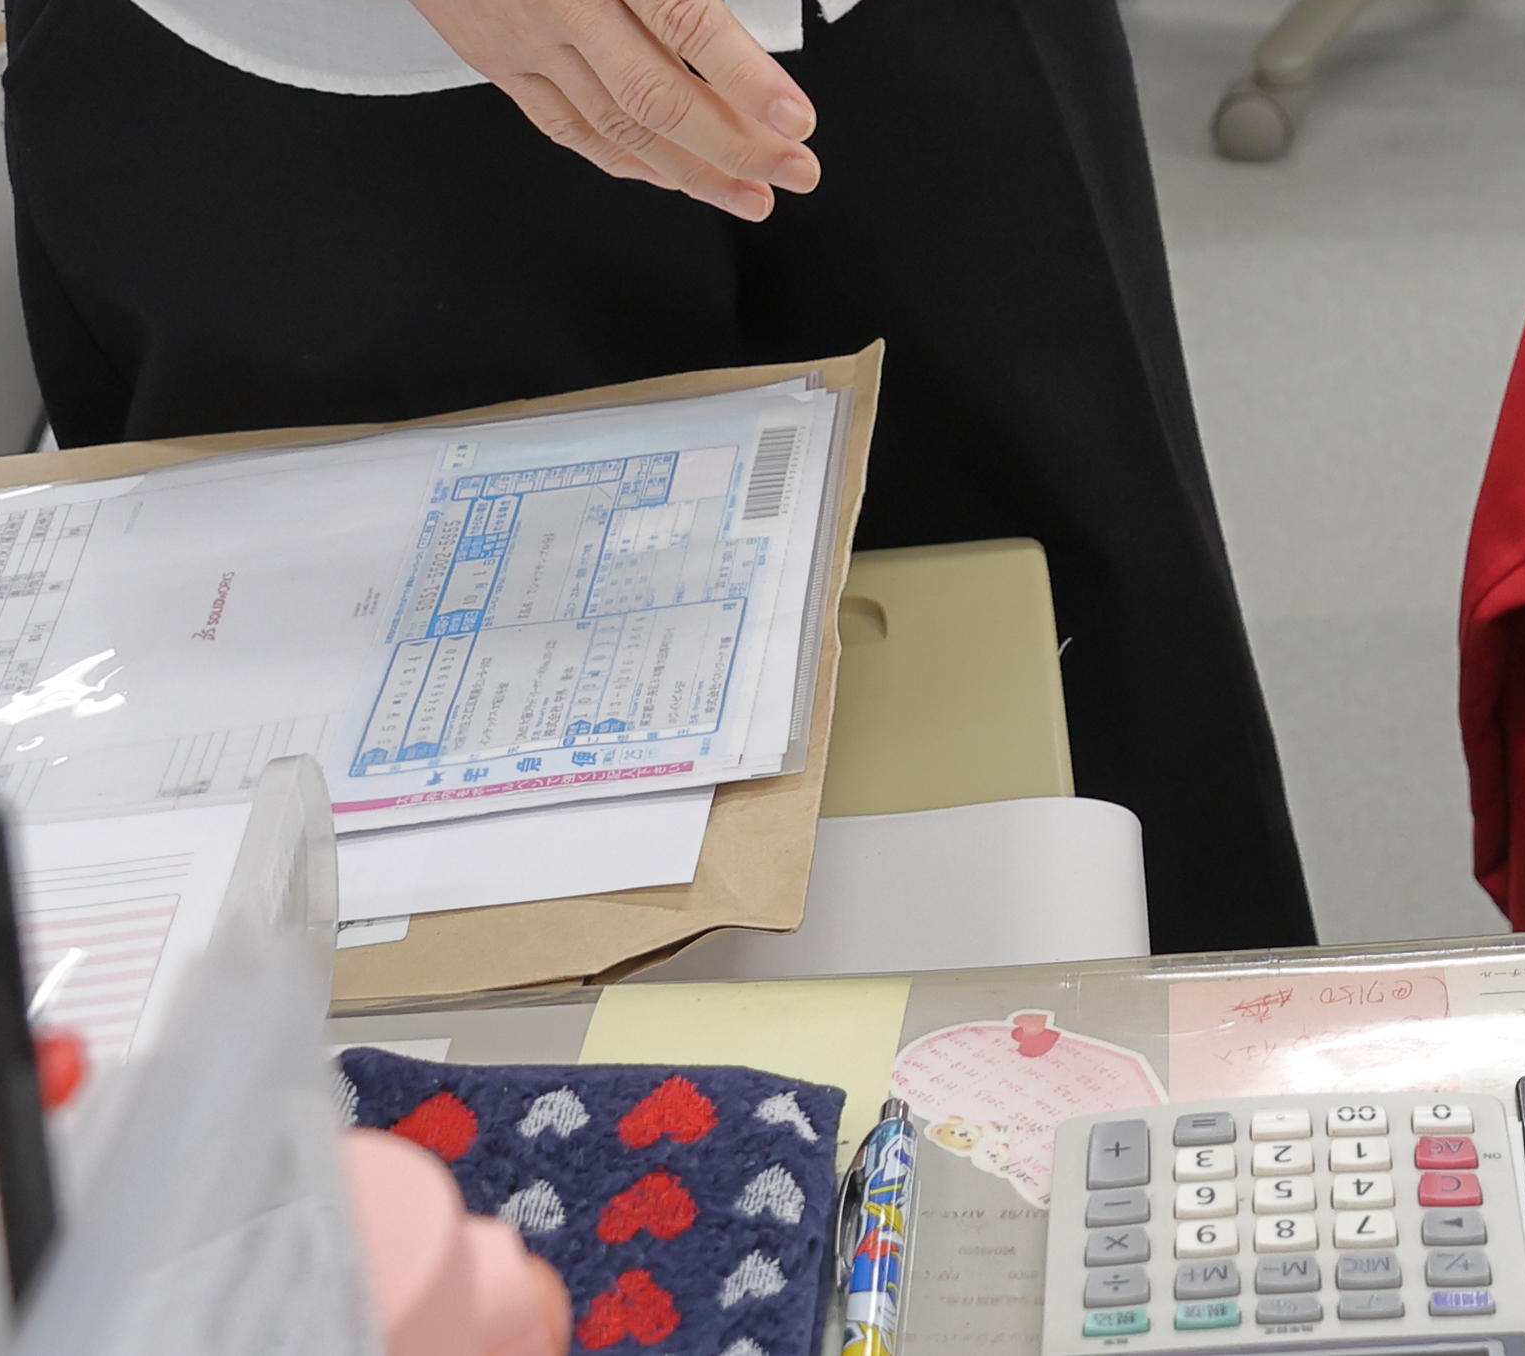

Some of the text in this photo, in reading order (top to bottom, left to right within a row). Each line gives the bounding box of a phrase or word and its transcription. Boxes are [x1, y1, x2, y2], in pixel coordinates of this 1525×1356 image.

[1336, 1104, 1453, 1122] 0 00
[1195, 1142, 1368, 1169] 1 2 3
[1428, 1139, 1502, 1160] ON AC
[1195, 1174, 1462, 1206] C 4 5 6
[1196, 1215, 1375, 1245] 7 8 9
[1342, 1256, 1390, 1276] MRC
